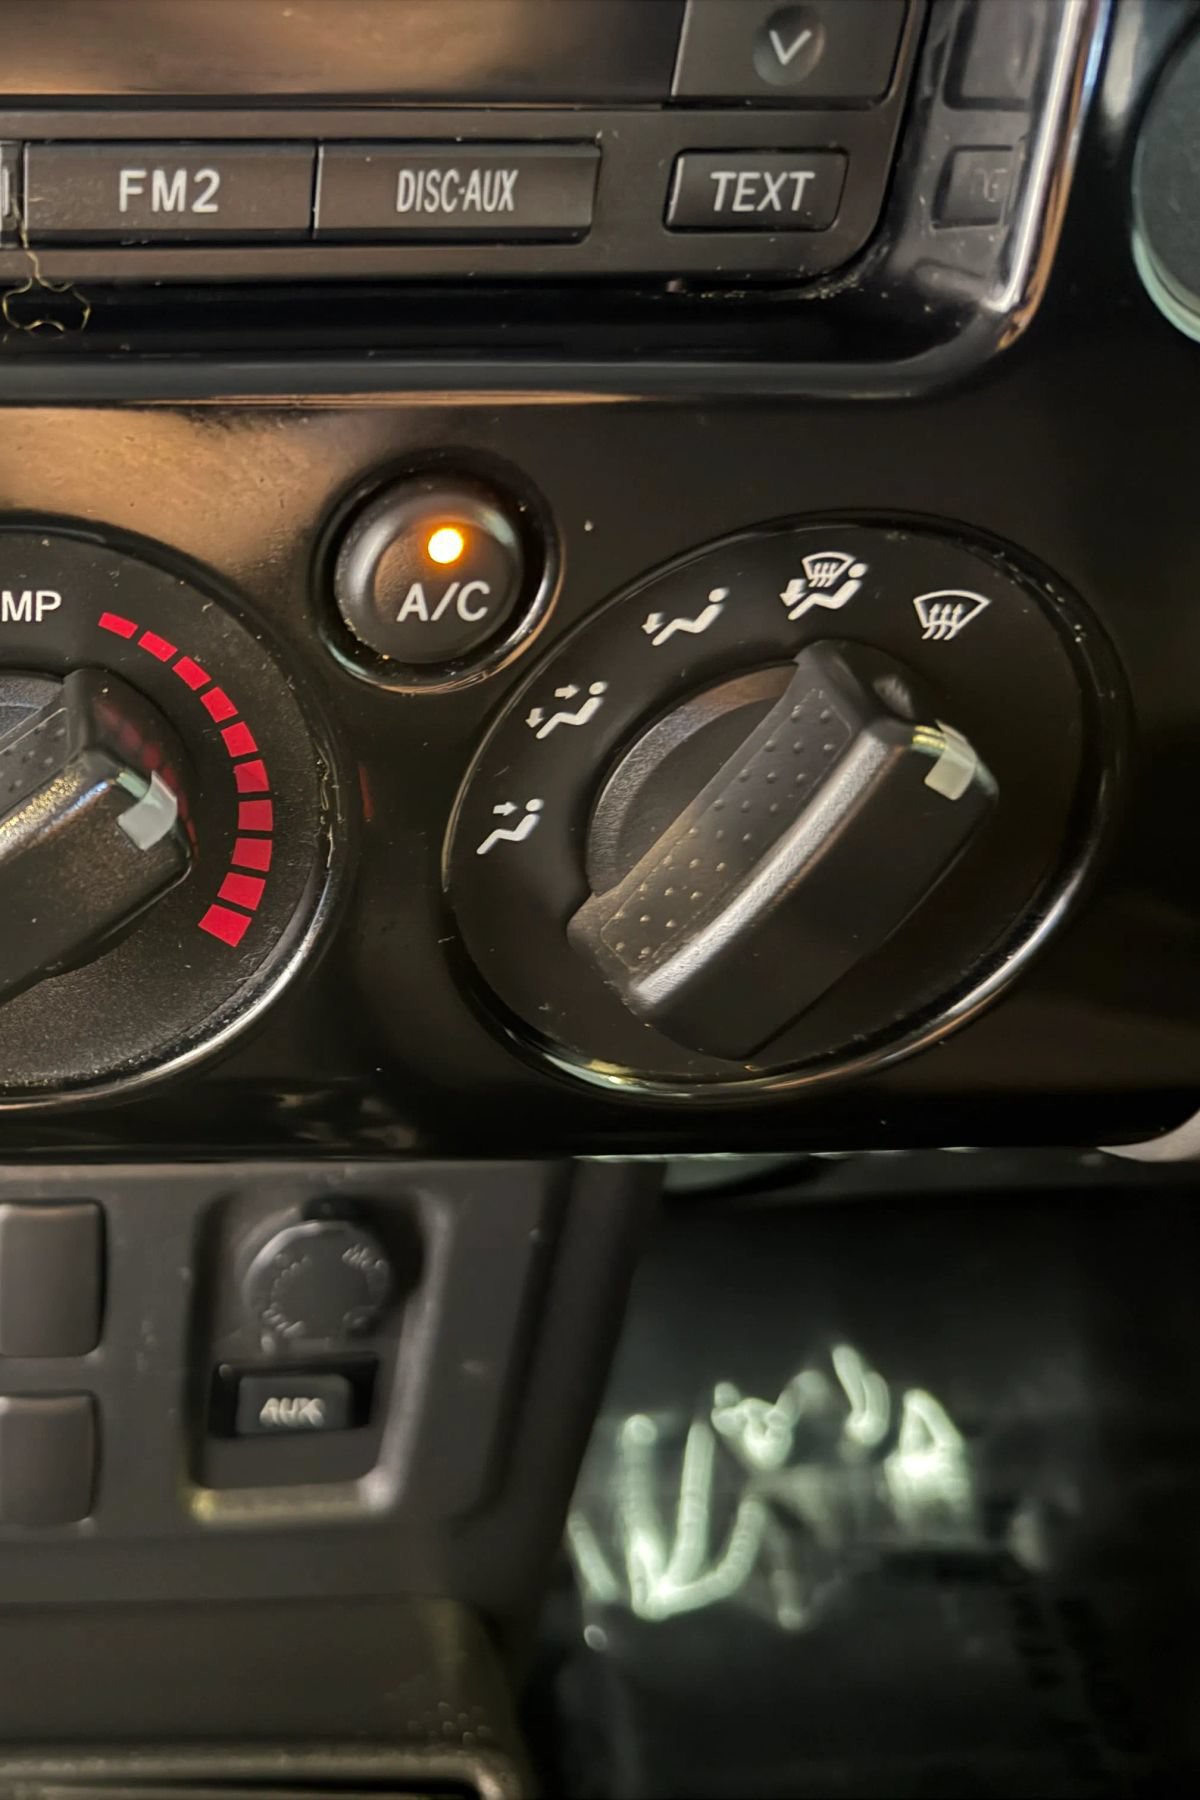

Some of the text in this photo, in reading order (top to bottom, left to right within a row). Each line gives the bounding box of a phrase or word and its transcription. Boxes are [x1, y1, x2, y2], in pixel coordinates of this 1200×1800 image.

[119, 168, 220, 213] FM2
[710, 170, 816, 212] TEXT
[396, 579, 491, 622] A/C
[260, 1397, 325, 1427] AUX
